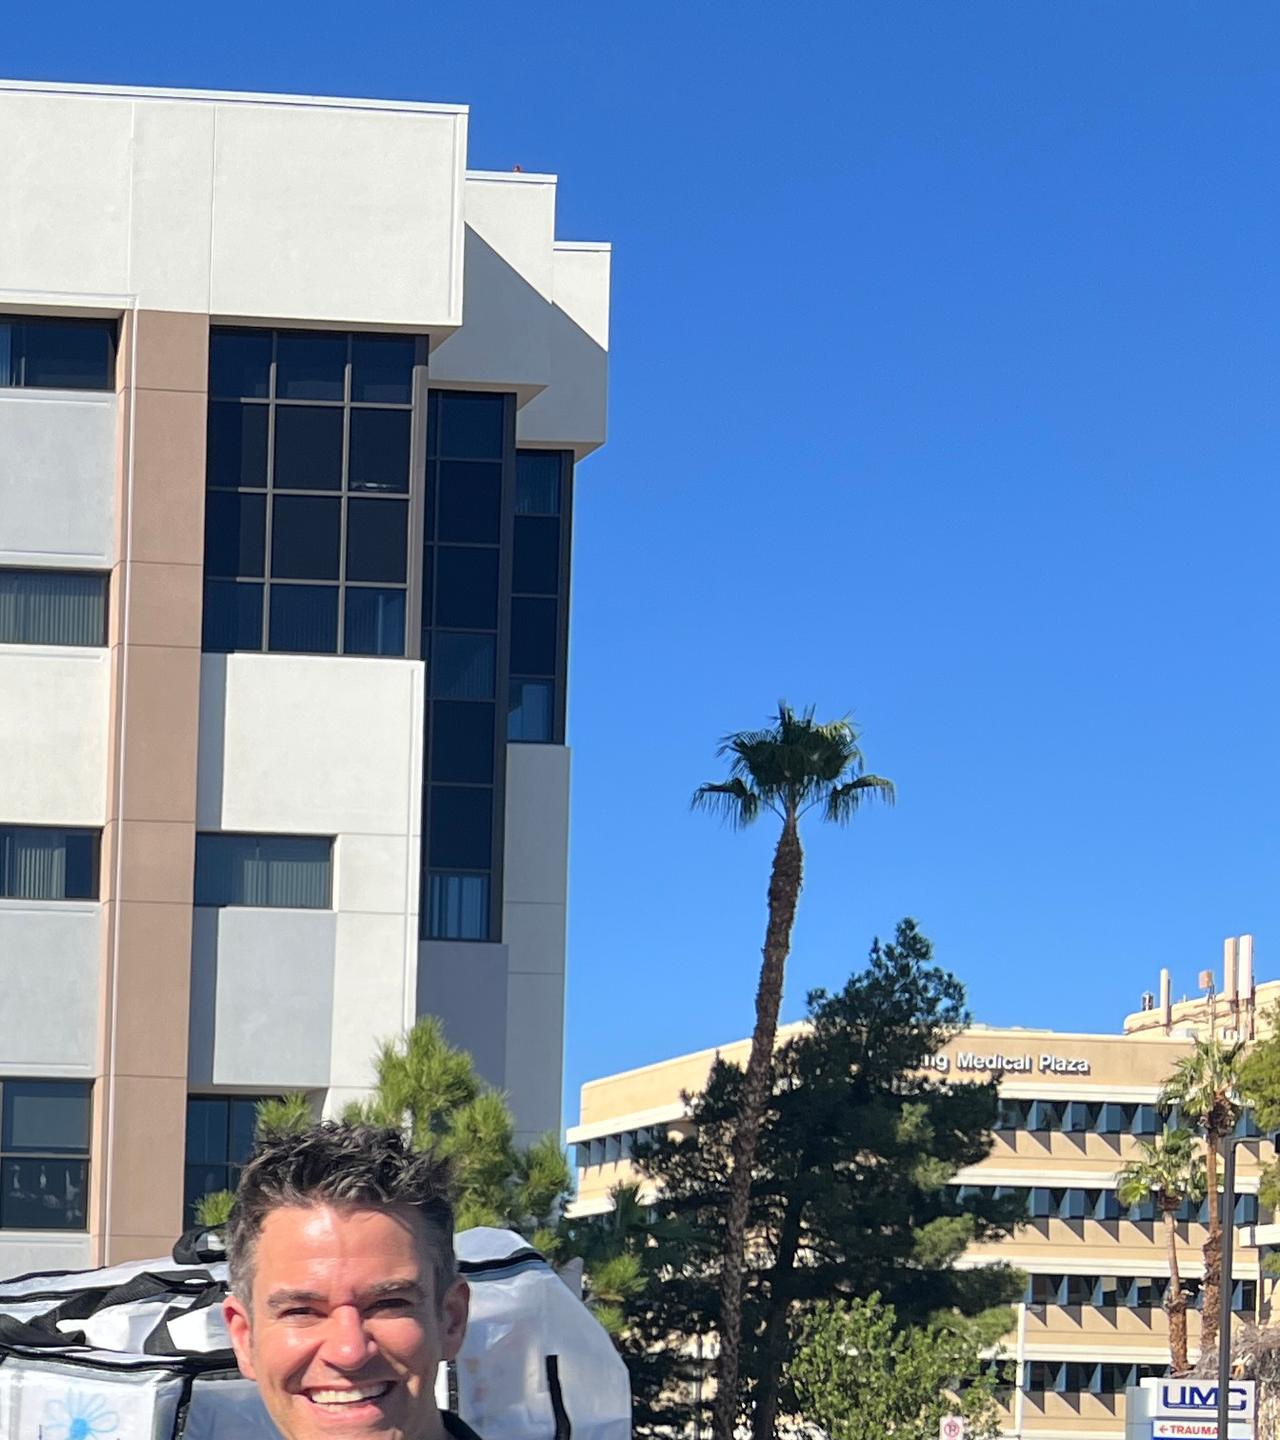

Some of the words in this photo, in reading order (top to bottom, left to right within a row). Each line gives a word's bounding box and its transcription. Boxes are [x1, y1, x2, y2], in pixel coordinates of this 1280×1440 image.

[957, 1052, 1031, 1070] Medical
[1040, 1055, 1089, 1071] Plaza
[1163, 1385, 1247, 1410] UMC
[1170, 1425, 1220, 1435] TRAUMA
